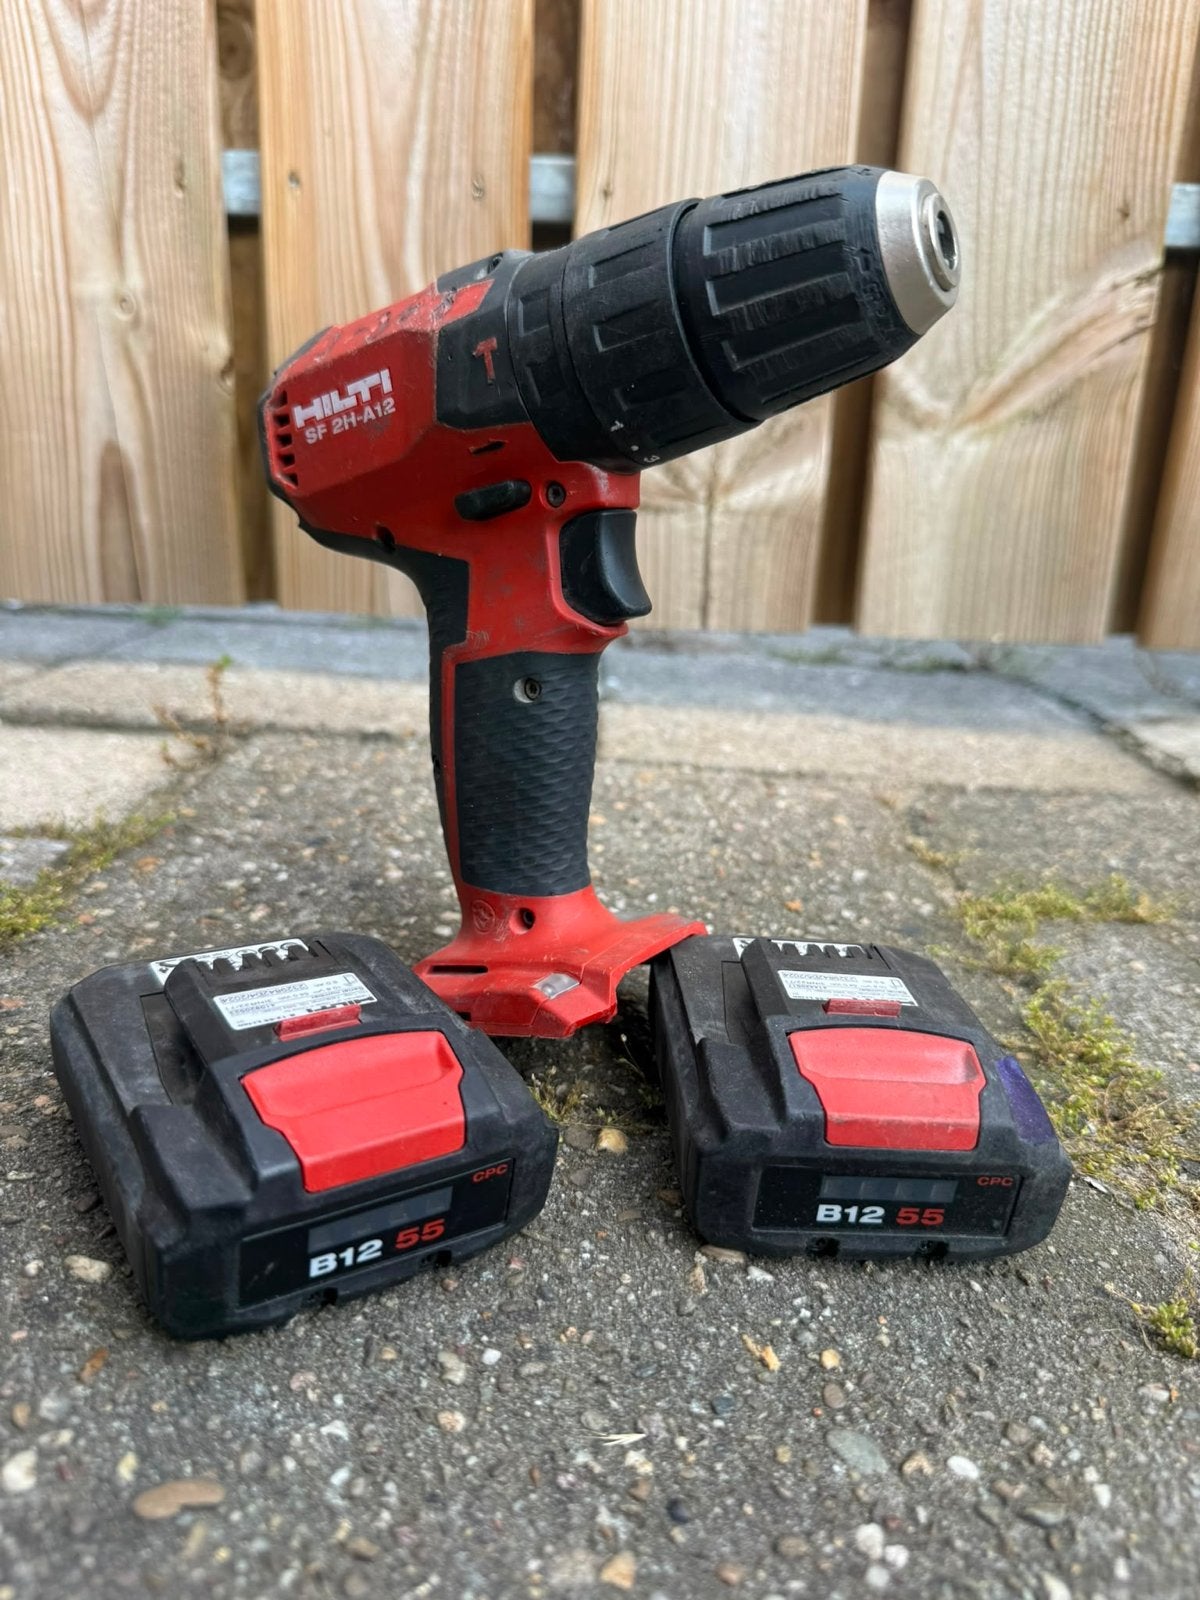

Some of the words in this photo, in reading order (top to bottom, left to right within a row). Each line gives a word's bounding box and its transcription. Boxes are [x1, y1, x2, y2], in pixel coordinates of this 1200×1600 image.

[293, 368, 393, 429] HILTI
[304, 424, 328, 445] SF
[332, 397, 396, 435] 2H-A12
[471, 1163, 508, 1183] CPC
[976, 1175, 1014, 1187] CPC
[815, 1203, 886, 1224] B12
[895, 1207, 946, 1226] 55
[308, 1238, 383, 1278] B12
[394, 1218, 446, 1250] 55
